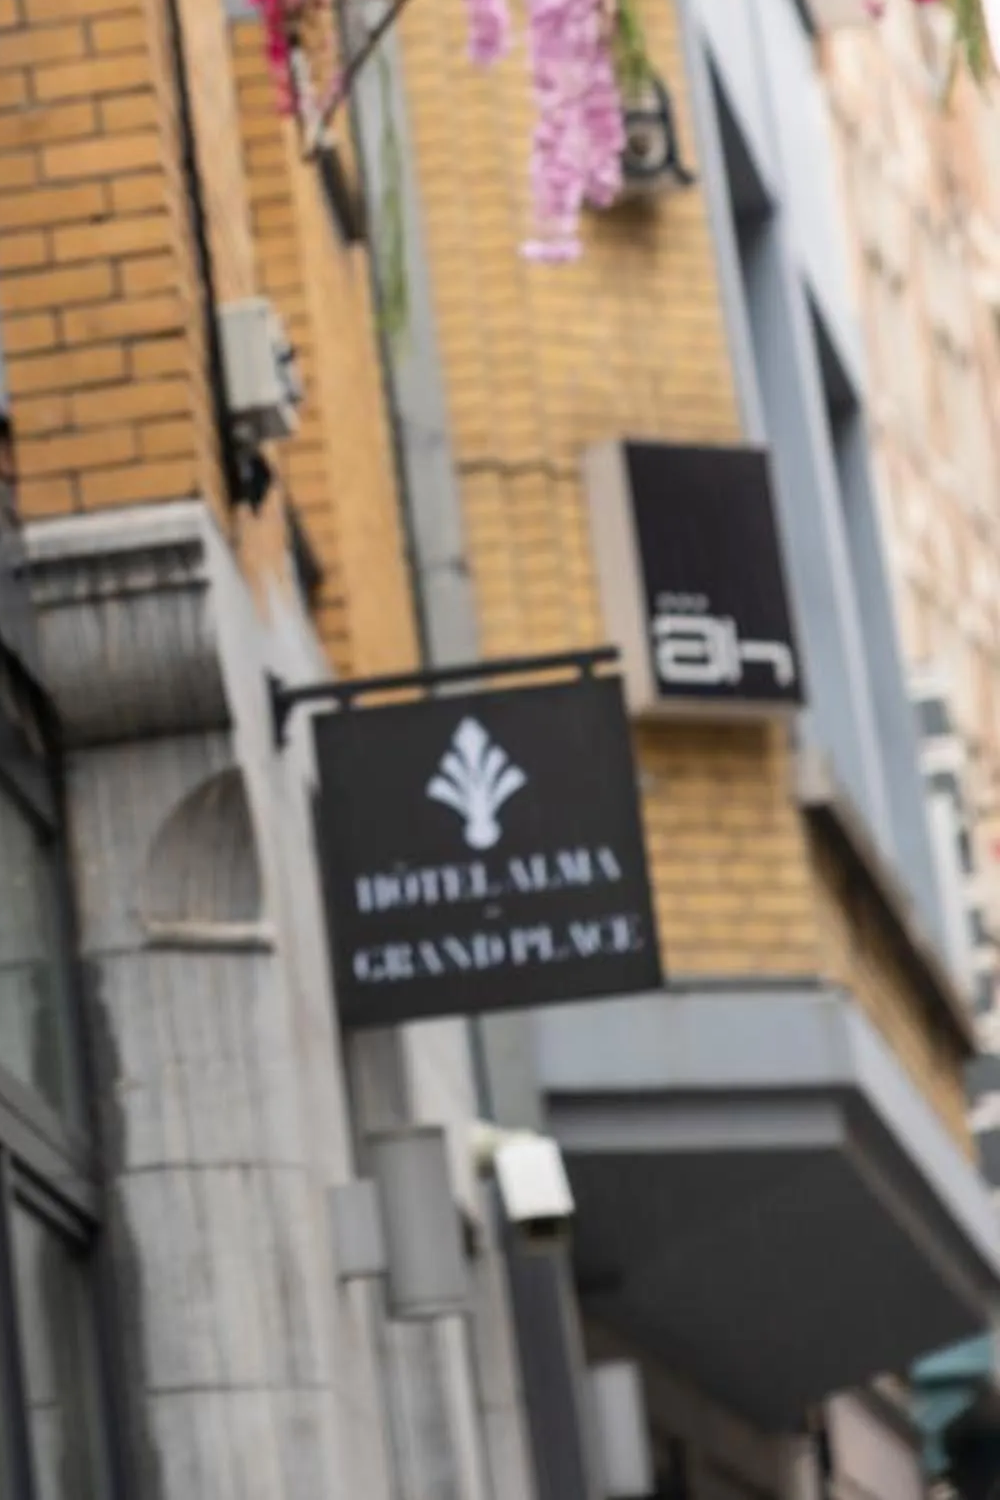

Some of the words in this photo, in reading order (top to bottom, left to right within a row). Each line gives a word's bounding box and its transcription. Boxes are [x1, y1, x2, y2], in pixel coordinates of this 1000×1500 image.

[506, 846, 623, 893] ALMA
[353, 932, 506, 982] GRAND
[508, 914, 644, 966] PLACE
